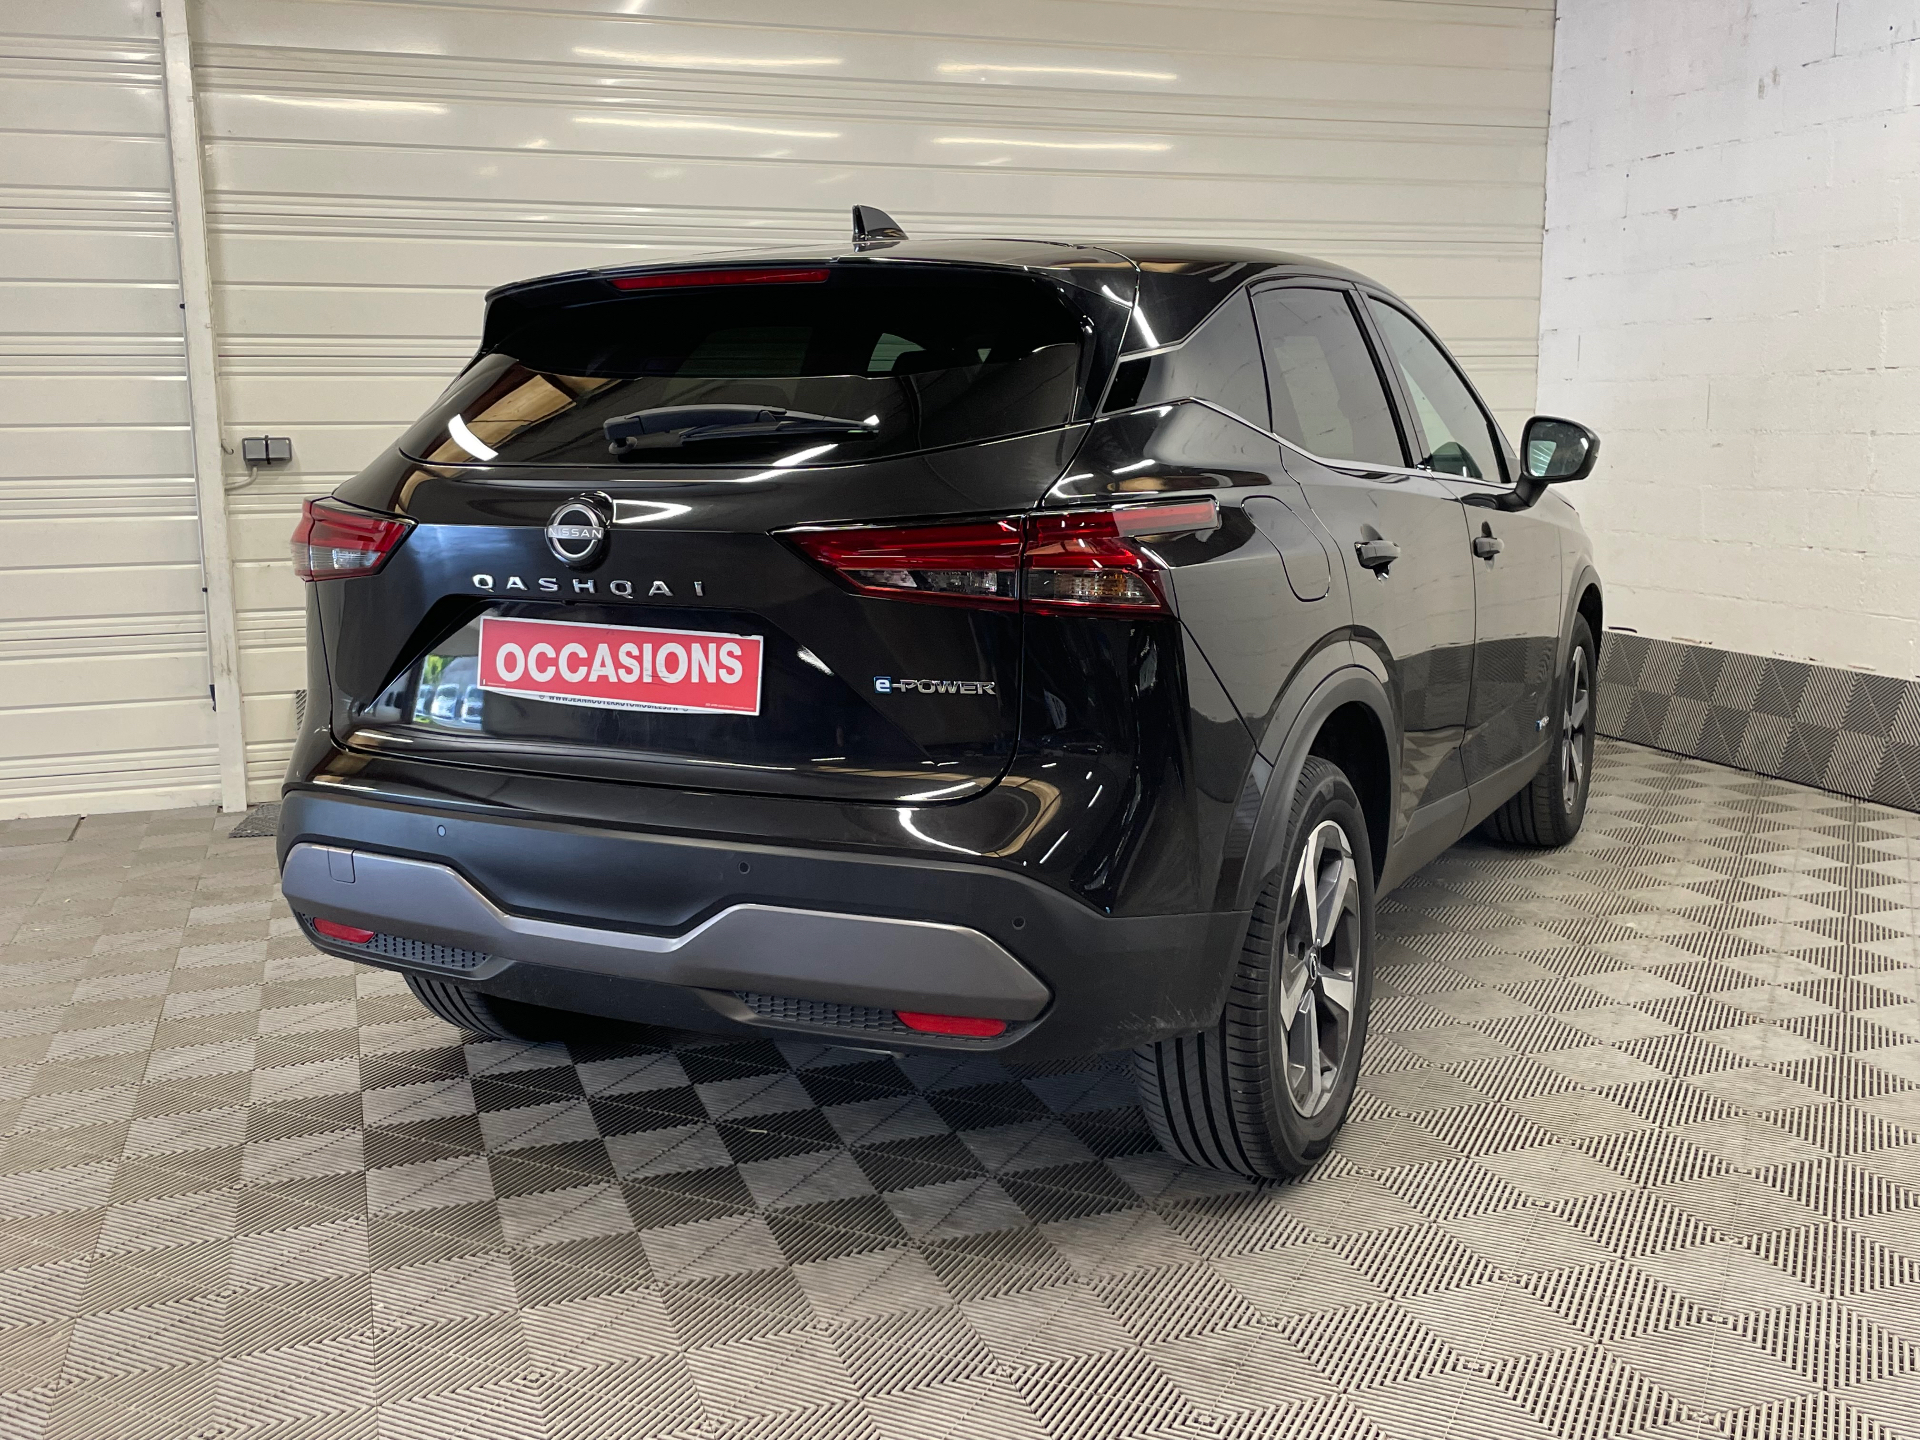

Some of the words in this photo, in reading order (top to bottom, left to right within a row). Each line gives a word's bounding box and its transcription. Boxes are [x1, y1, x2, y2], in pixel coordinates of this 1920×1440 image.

[549, 527, 602, 539] NISSAN
[472, 574, 704, 599] QASHQAI
[495, 642, 743, 685] OCCASIONS
[874, 676, 997, 695] e-POWER
